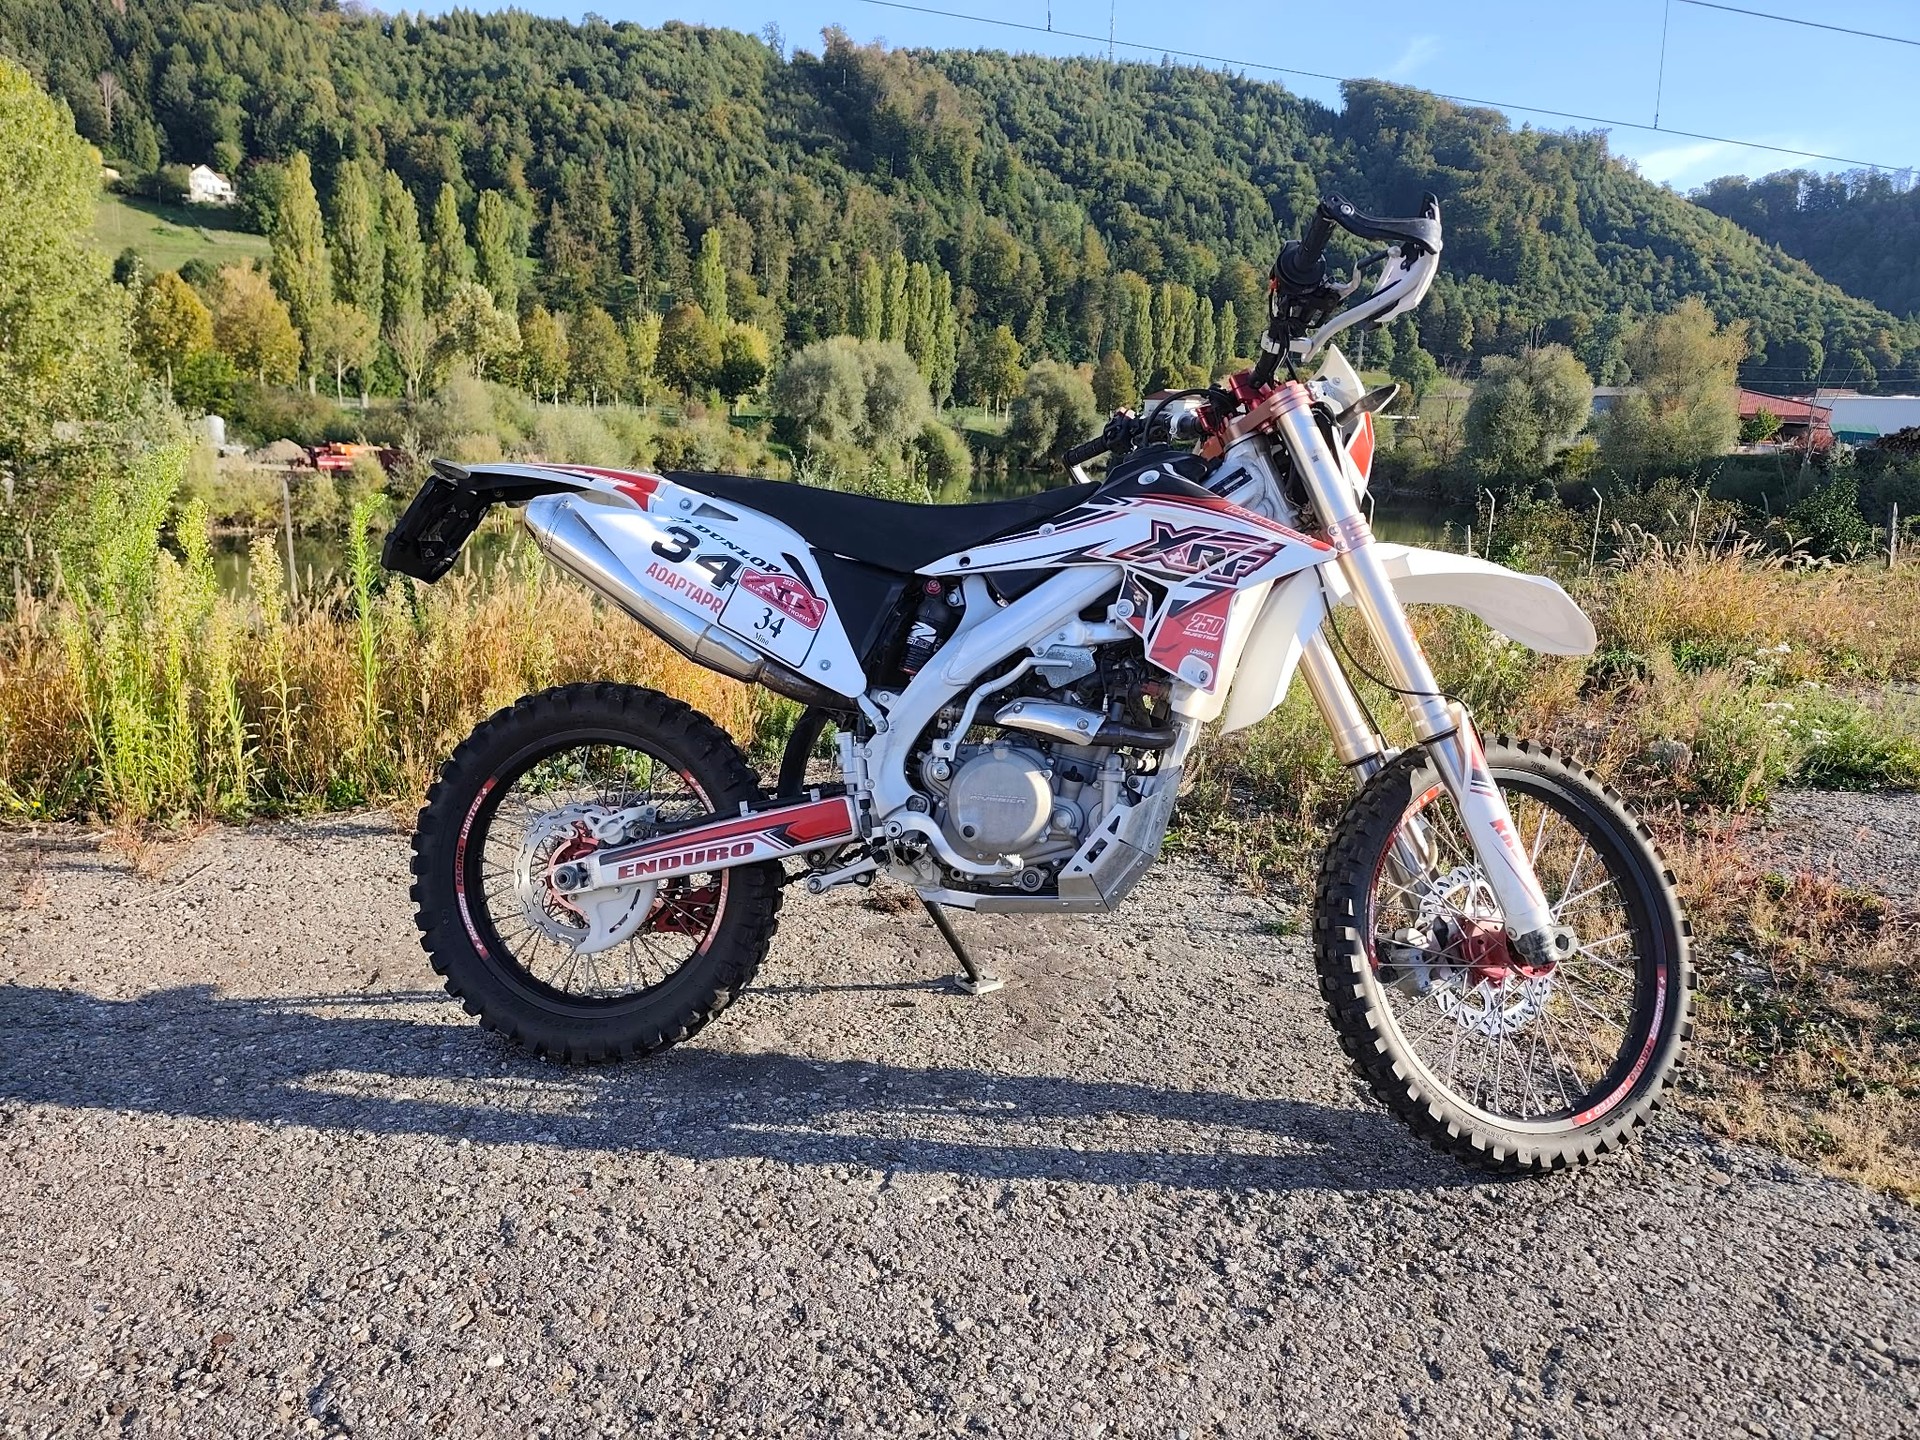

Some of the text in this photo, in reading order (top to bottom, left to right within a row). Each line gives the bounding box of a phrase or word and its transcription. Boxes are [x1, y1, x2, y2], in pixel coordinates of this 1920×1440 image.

[651, 525, 744, 591] 34
[692, 524, 781, 573] DUNLOP
[1108, 519, 1287, 584] XRF
[646, 562, 724, 614] ADAPTAPR
[753, 607, 786, 639] 34
[788, 608, 812, 623] TROPHY
[1185, 612, 1226, 636] 250
[456, 845, 465, 887] RACING
[461, 796, 482, 840] LIMITED
[618, 842, 755, 880] ENDURO
[1629, 1043, 1651, 1082] RACING
[1593, 1083, 1629, 1116] LIMITED
